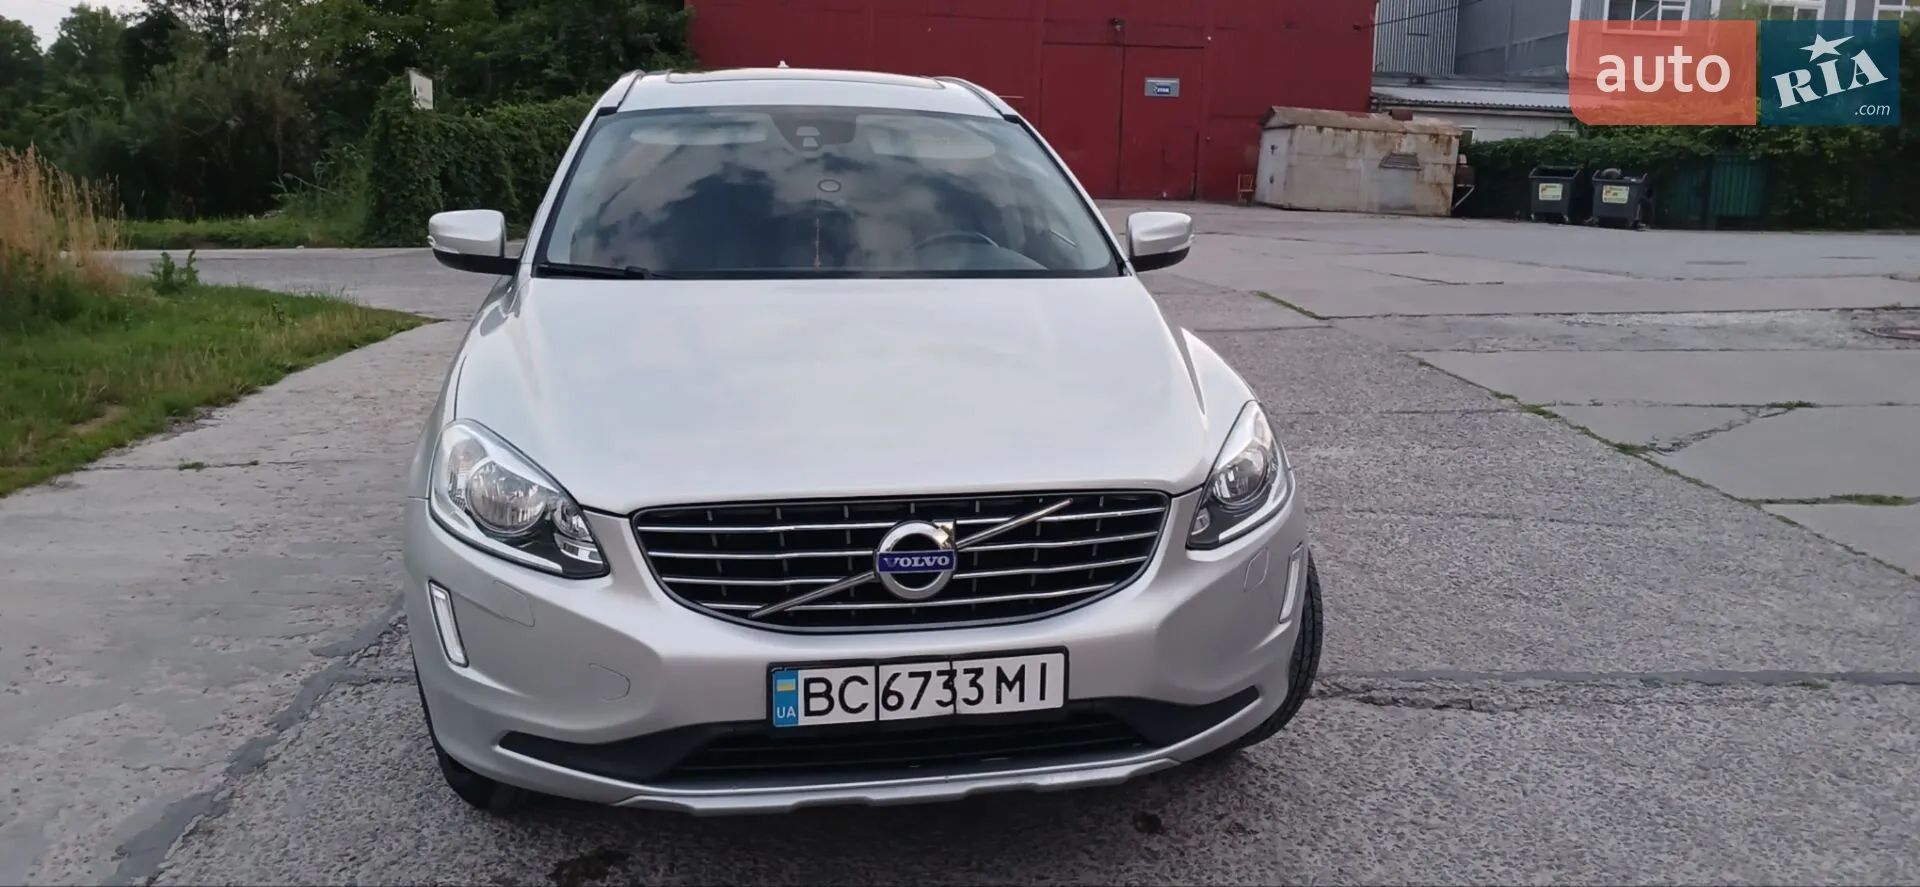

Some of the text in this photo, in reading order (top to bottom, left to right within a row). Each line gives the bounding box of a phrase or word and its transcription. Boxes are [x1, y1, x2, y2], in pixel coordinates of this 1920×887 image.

[883, 555, 950, 568] VOLVO
[803, 675, 869, 717] BC
[996, 662, 1047, 704] MI
[776, 706, 796, 720] UA
